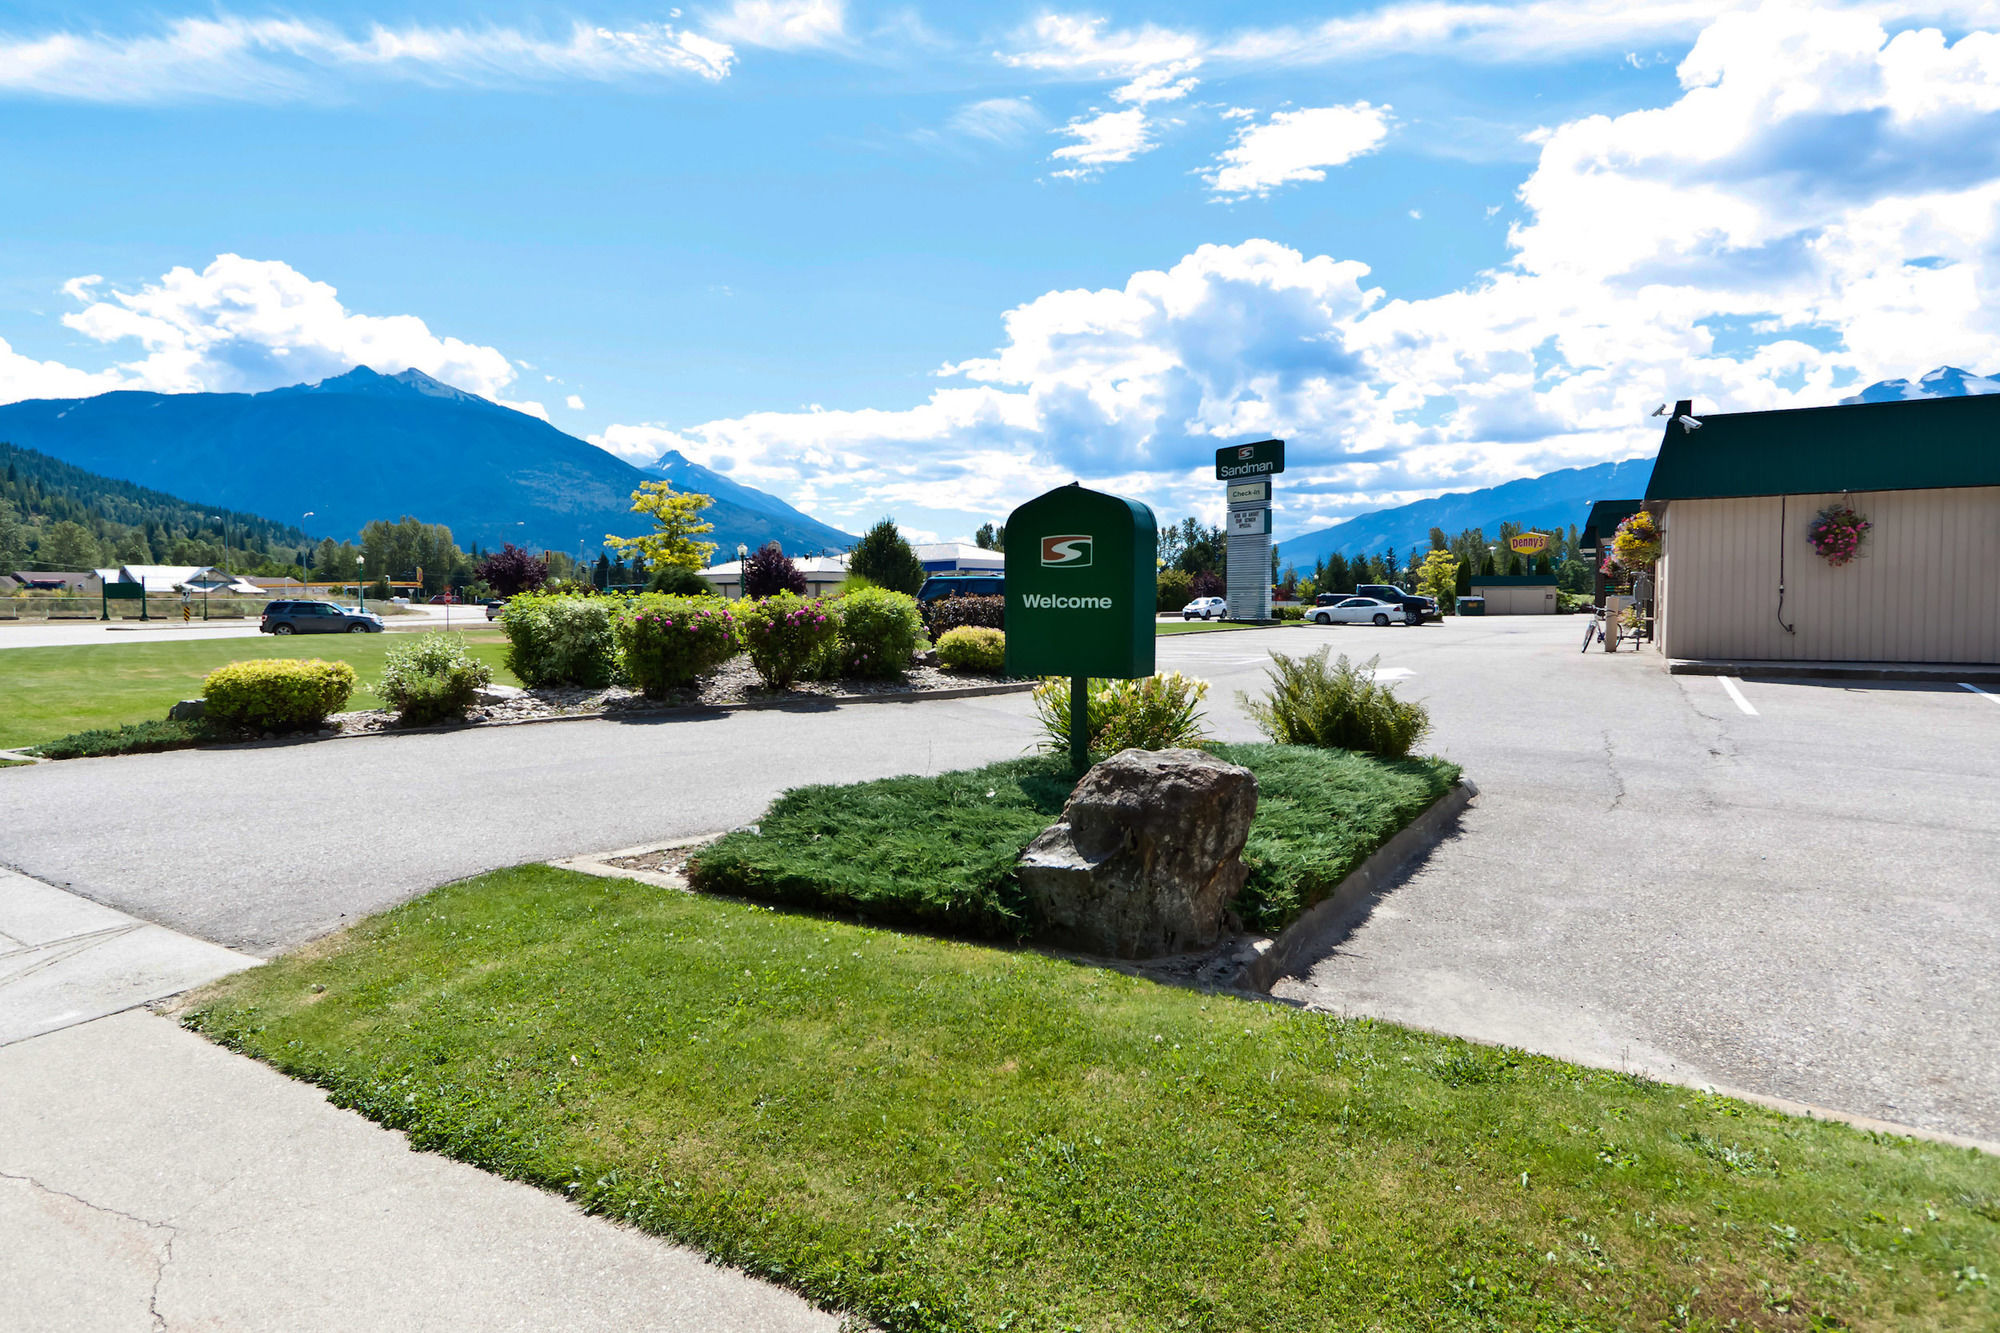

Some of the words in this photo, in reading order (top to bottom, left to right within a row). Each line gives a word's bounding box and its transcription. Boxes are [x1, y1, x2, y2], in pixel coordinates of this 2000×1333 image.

[1221, 461, 1273, 477] Sandman
[1232, 489, 1260, 498] Check-in
[1512, 536, 1544, 549] Denny's
[1022, 594, 1112, 609] Welcome
